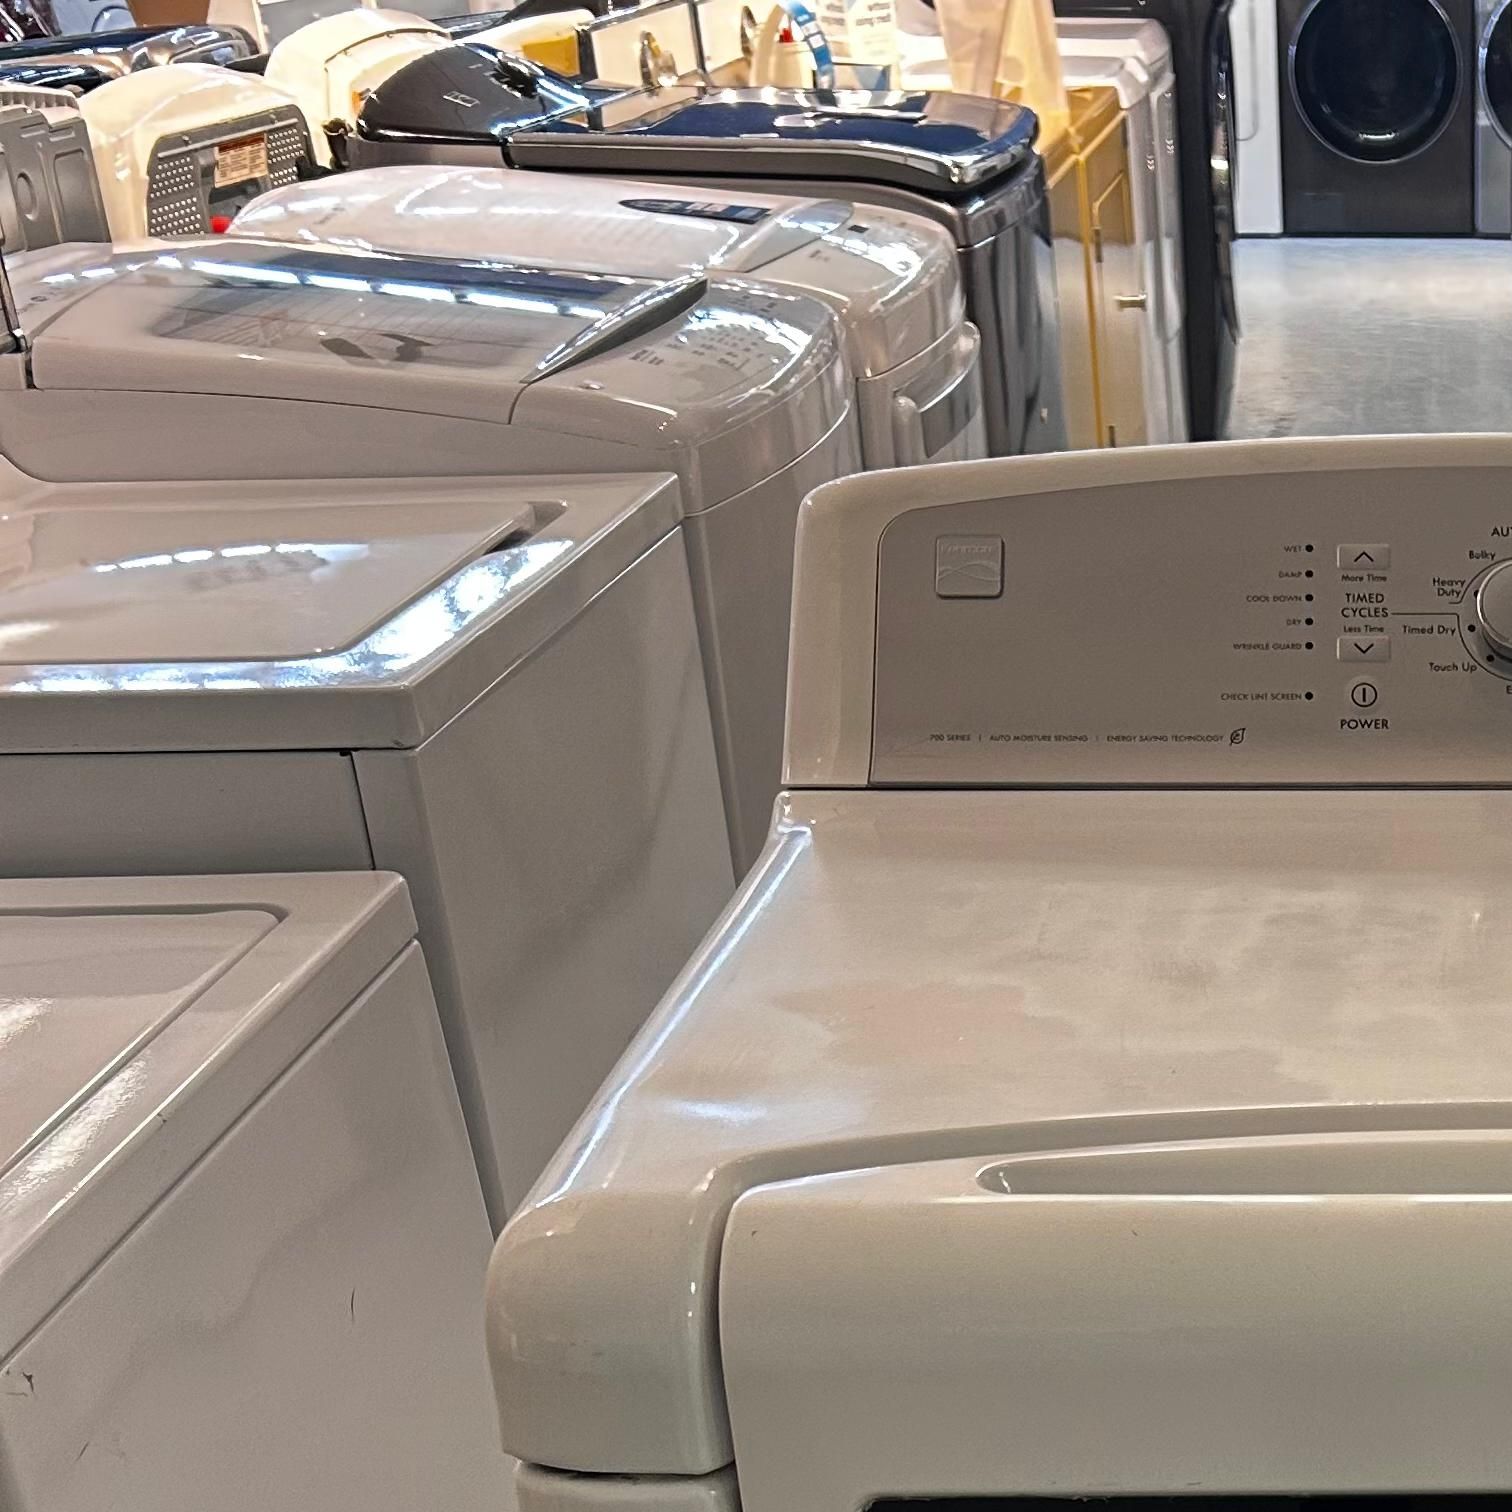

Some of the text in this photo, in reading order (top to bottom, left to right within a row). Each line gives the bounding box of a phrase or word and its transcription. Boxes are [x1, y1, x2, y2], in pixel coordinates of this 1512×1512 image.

[1468, 550, 1496, 561] Bulky
[1341, 574, 1388, 582] More Time
[1432, 577, 1466, 588] Heavy
[1345, 592, 1385, 604] TIMED
[1437, 588, 1461, 598] Duty
[1340, 607, 1389, 618] CYCLES
[1344, 625, 1384, 633] Less Time
[1403, 624, 1456, 636] Timed Dry
[1429, 662, 1478, 674] Touch Up
[1340, 718, 1389, 730] POWER
[990, 734, 1011, 742] AUTO
